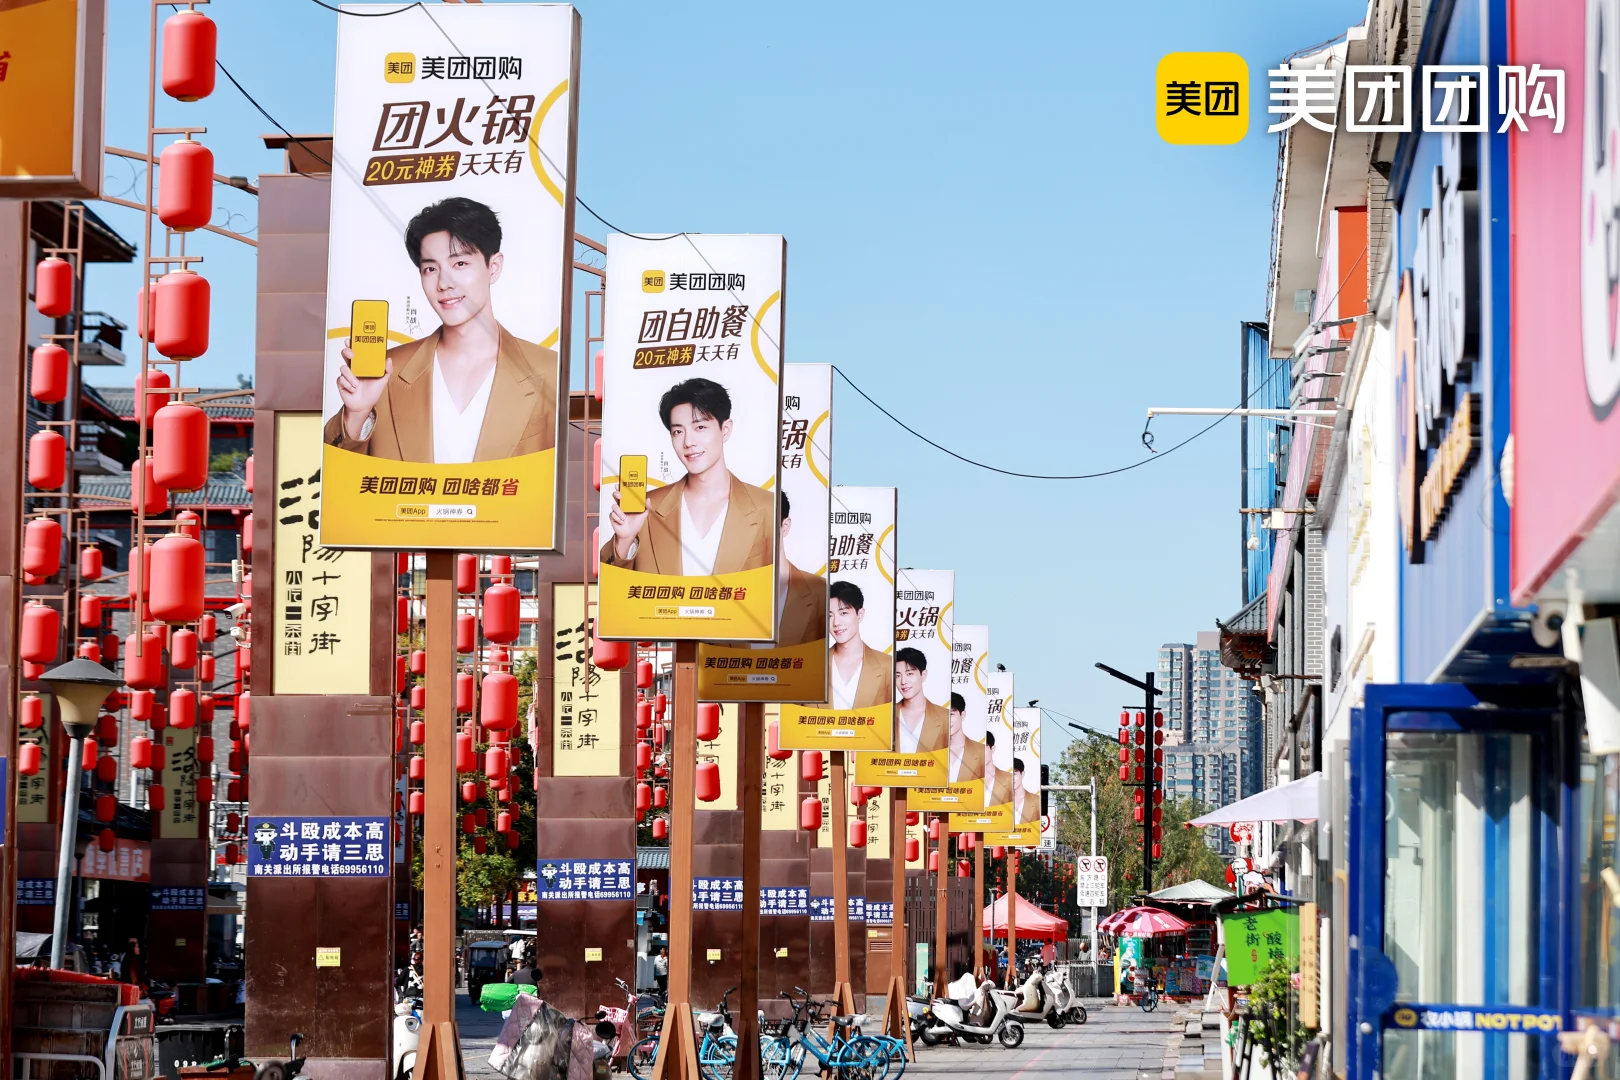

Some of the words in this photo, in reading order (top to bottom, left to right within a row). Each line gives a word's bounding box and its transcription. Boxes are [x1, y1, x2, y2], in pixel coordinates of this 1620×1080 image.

[387, 62, 413, 74] 美团
[421, 56, 522, 80] 美团团购
[371, 95, 535, 151] 团火锅
[367, 155, 456, 181] 20元神券
[460, 150, 525, 177] 天天有
[643, 277, 664, 287] 美团
[669, 273, 745, 291] 美团团购
[638, 305, 749, 343] 团自助餐
[635, 346, 693, 366] 20元神券
[695, 343, 740, 362] 天天有
[785, 395, 800, 411] 购
[359, 476, 436, 496] 美团团购
[442, 477, 520, 497] 团啥都省
[400, 507, 426, 516] 美团App
[840, 558, 869, 571] 天天有
[628, 585, 684, 600] 美团团购
[689, 585, 747, 601] 团啥都省
[704, 656, 753, 670] 美团团购
[755, 656, 804, 670] 团啥都省
[798, 715, 836, 725] 美团团购
[838, 716, 876, 726] 团啥都省
[870, 757, 901, 767] 美团团购
[279, 821, 385, 841] 斗殴成本高
[279, 843, 385, 862] 动手请三思
[254, 863, 384, 875] 南关派出所报警电话69956110
[559, 862, 631, 875] 斗殴成本高
[559, 877, 631, 890] 动手请三思
